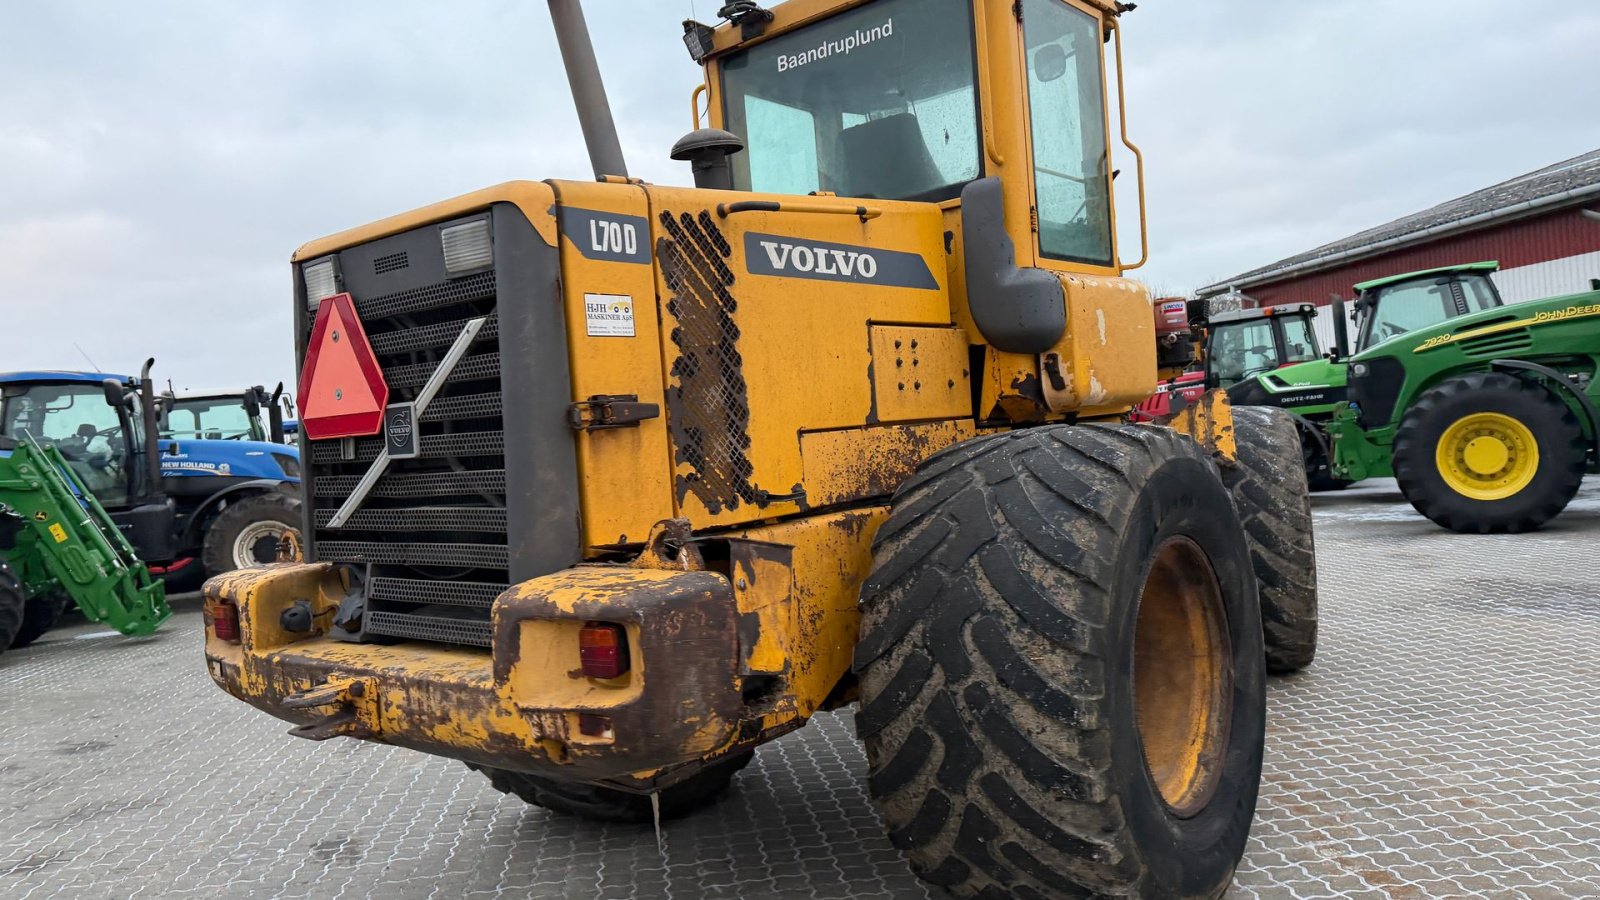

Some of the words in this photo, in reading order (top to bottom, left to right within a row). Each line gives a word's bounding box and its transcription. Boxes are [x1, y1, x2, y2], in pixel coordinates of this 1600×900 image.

[777, 18, 893, 72] Baandruplund
[760, 241, 877, 278] VOLVO
[587, 303, 607, 313] HJH
[587, 313, 621, 321] MASKINER
[1533, 310, 1565, 321] JOHN
[1424, 333, 1451, 346] 7920
[1281, 394, 1324, 403] DEUTZ-FAHR
[180, 461, 215, 469] HOLLAND
